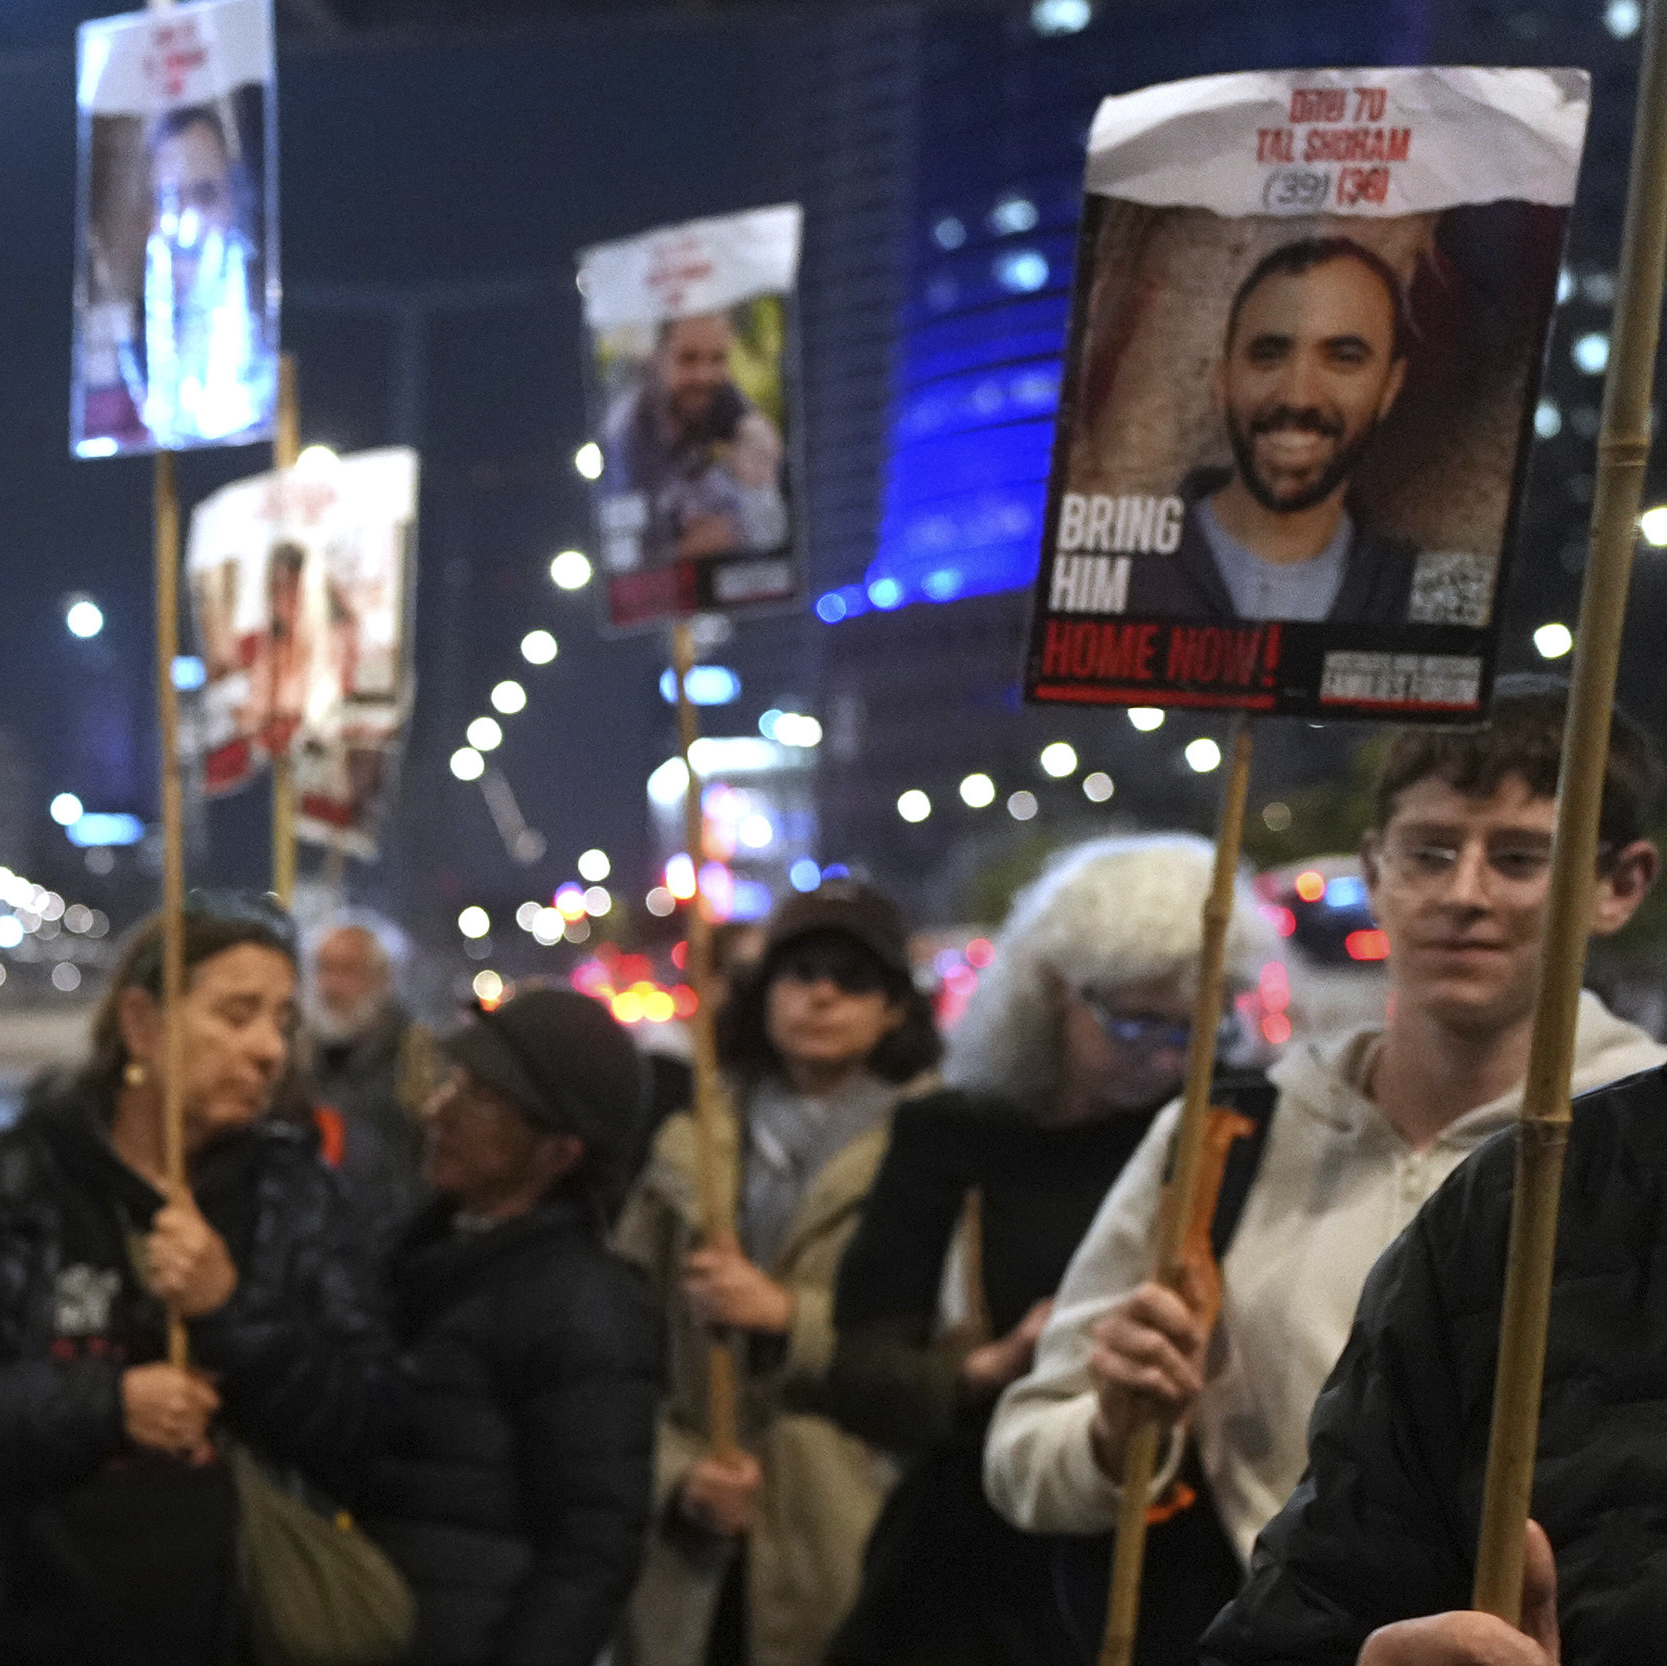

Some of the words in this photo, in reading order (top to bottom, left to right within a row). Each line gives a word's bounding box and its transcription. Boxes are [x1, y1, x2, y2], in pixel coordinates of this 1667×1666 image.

[1256, 128, 1294, 163] TAL
[1056, 493, 1185, 555] BRING
[1049, 554, 1132, 614] HIM
[1041, 619, 1160, 680] HOME
[1168, 622, 1283, 687] NOW!
